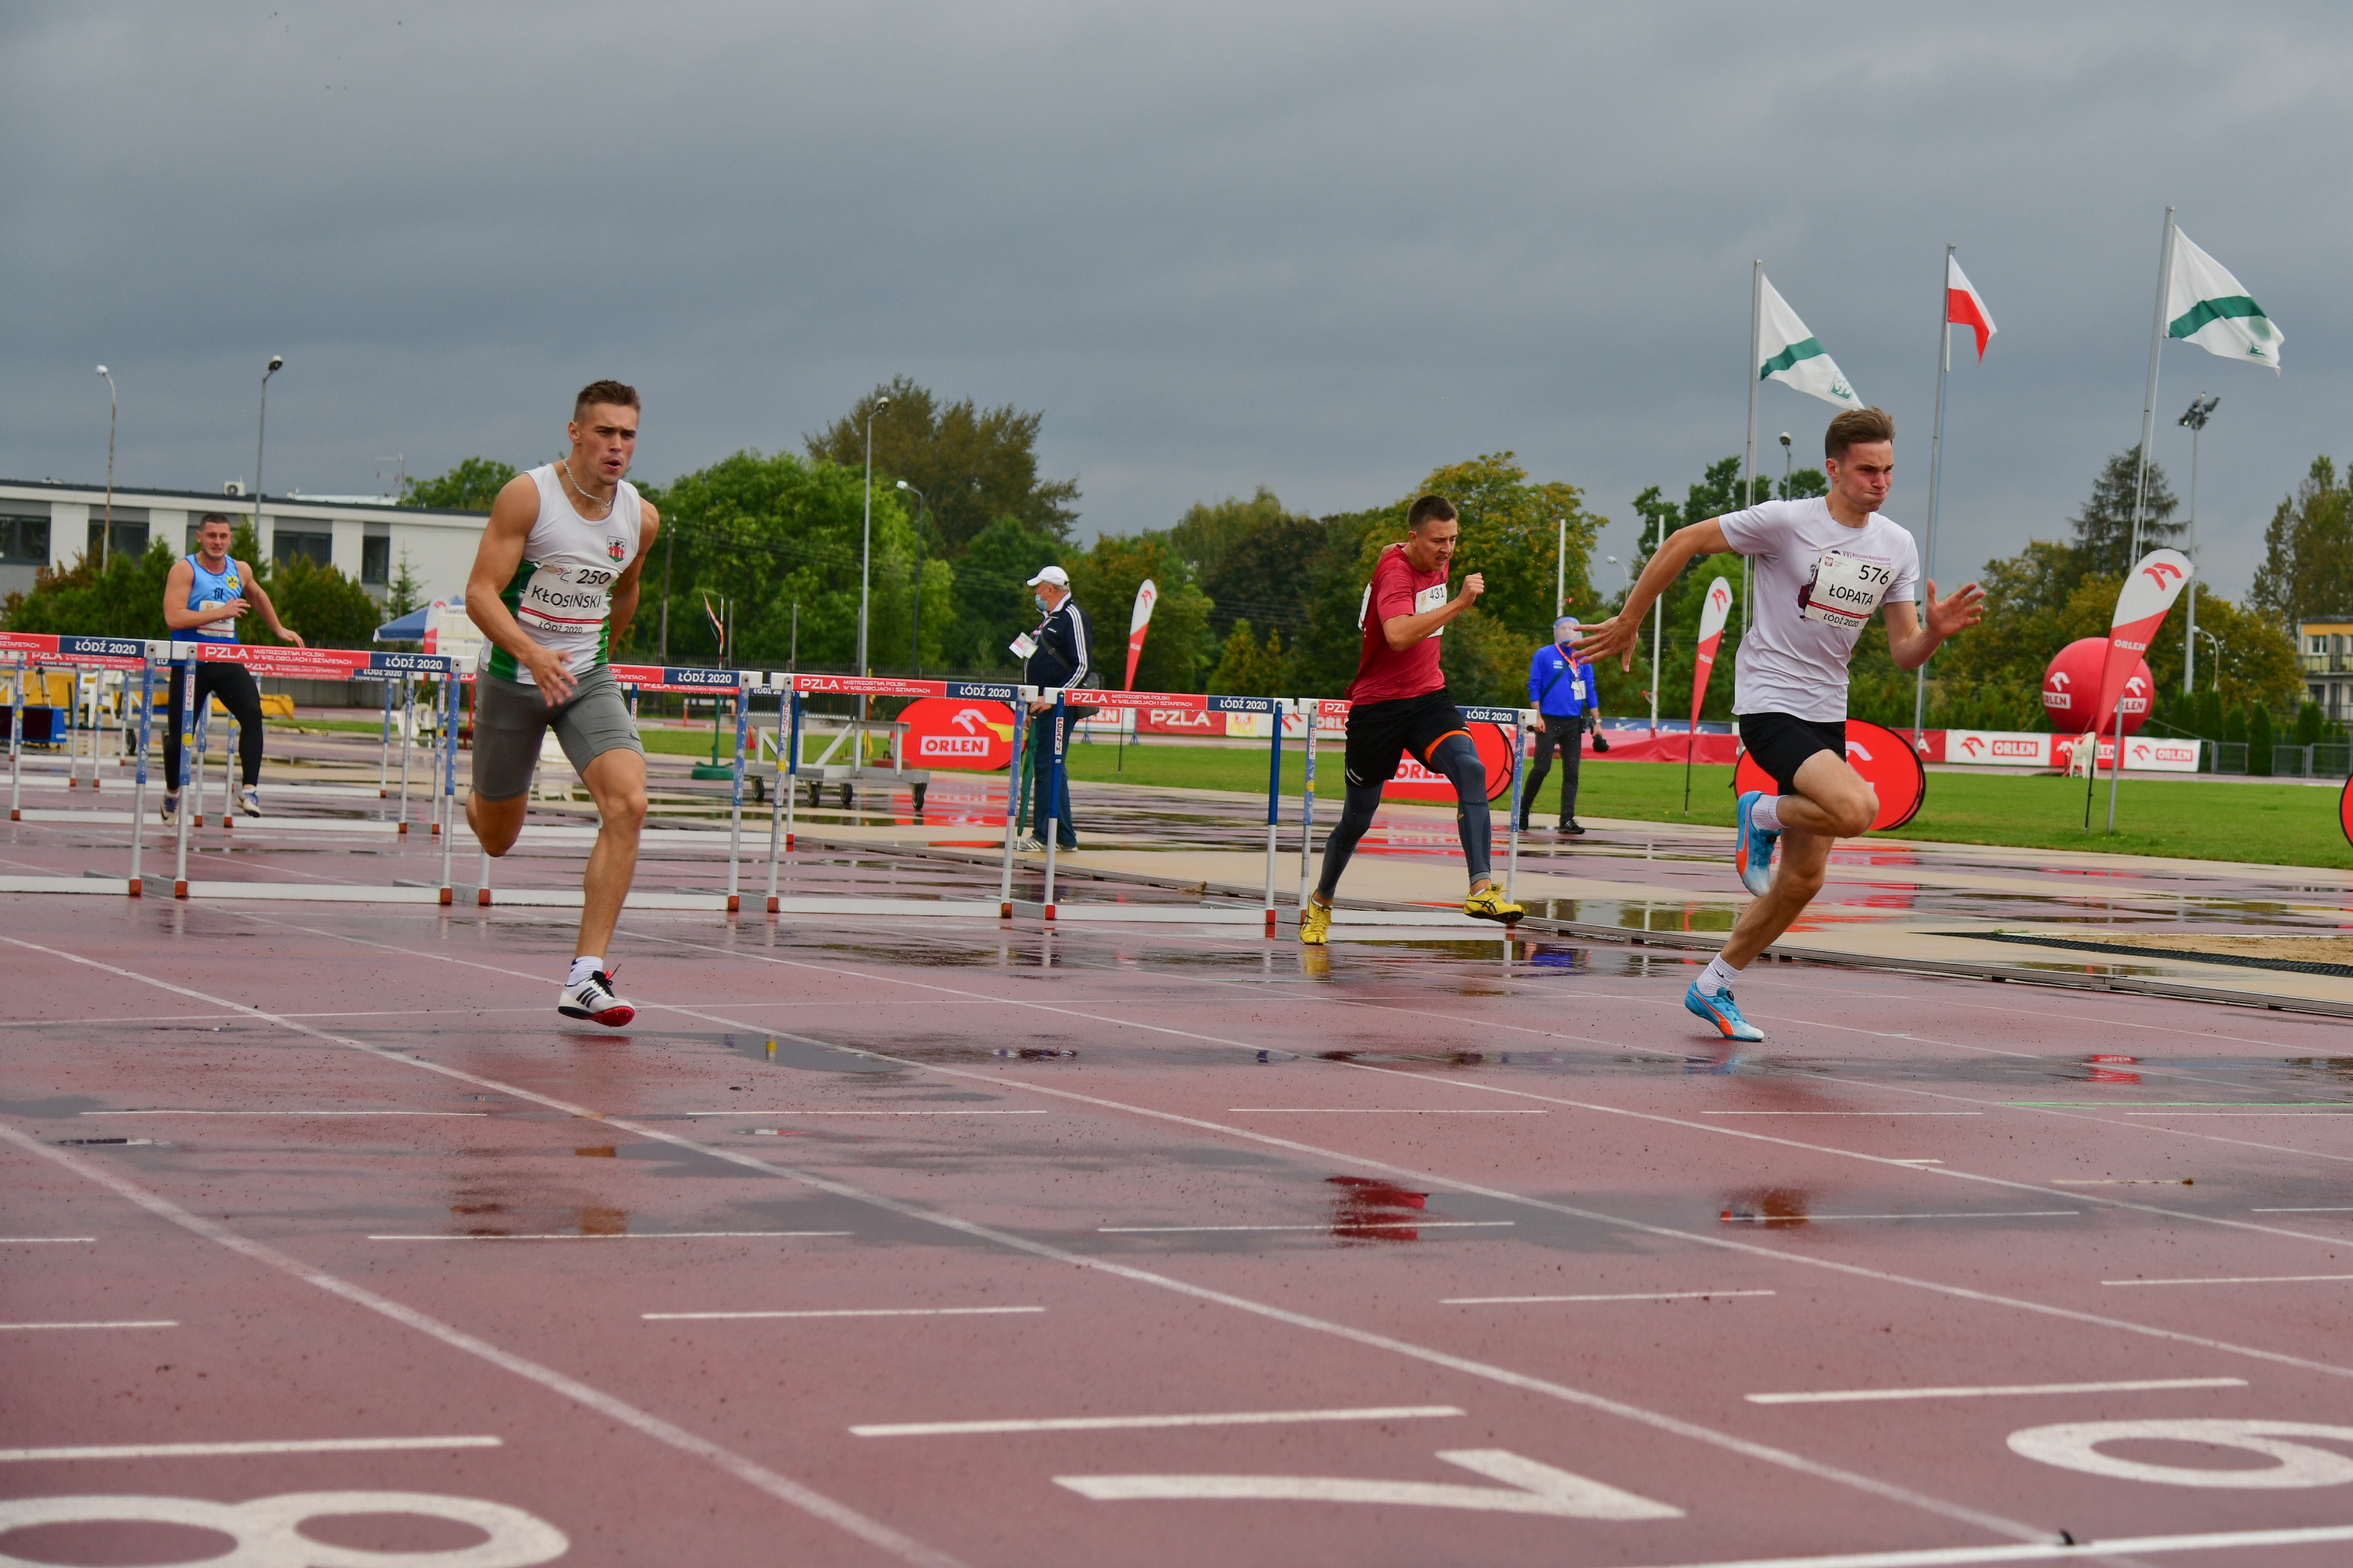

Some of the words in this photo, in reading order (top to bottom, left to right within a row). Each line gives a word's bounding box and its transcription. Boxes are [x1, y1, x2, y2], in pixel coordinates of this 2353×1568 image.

[576, 569, 611, 584] 250
[1859, 564, 1891, 585] 576
[531, 585, 602, 608] KŁOSIŃSKI
[1430, 586, 1444, 600] 431
[1829, 584, 1874, 606] ŁOPATA
[539, 621, 562, 631] ŁÓDŹ
[1824, 613, 1844, 624] ŁÓDŹ
[1844, 619, 1859, 627] 2020
[75, 639, 106, 653] ŁÓDŹ
[108, 643, 137, 655] 2020
[2114, 639, 2146, 651] ORLEN
[205, 646, 249, 659] PZLA
[384, 655, 414, 669] ŁÓDŹ
[417, 659, 443, 670] 2020
[677, 670, 705, 683] ŁÓDŹ
[707, 674, 732, 684] 2020
[800, 678, 840, 690] PZLA
[959, 684, 987, 696] ŁÓDŹ
[988, 687, 1011, 698] 2020
[1072, 692, 1108, 704] PZLA
[1219, 696, 1244, 709] ŁÓDŹ
[1245, 700, 1268, 710] 2020
[1325, 703, 1350, 713] PZL
[2122, 701, 2144, 709] LEN
[1150, 709, 1212, 726] PZLA
[1466, 708, 1490, 720] ŁÓDŹ
[1491, 711, 1513, 721] 2020
[1316, 716, 1349, 729] ORL
[925, 739, 985, 753] ORLEN
[1993, 741, 2036, 755] ORLEN
[2156, 750, 2192, 760] ORLEN
[1396, 763, 1448, 779] ORL
[1052, 1449, 1688, 1520] 7
